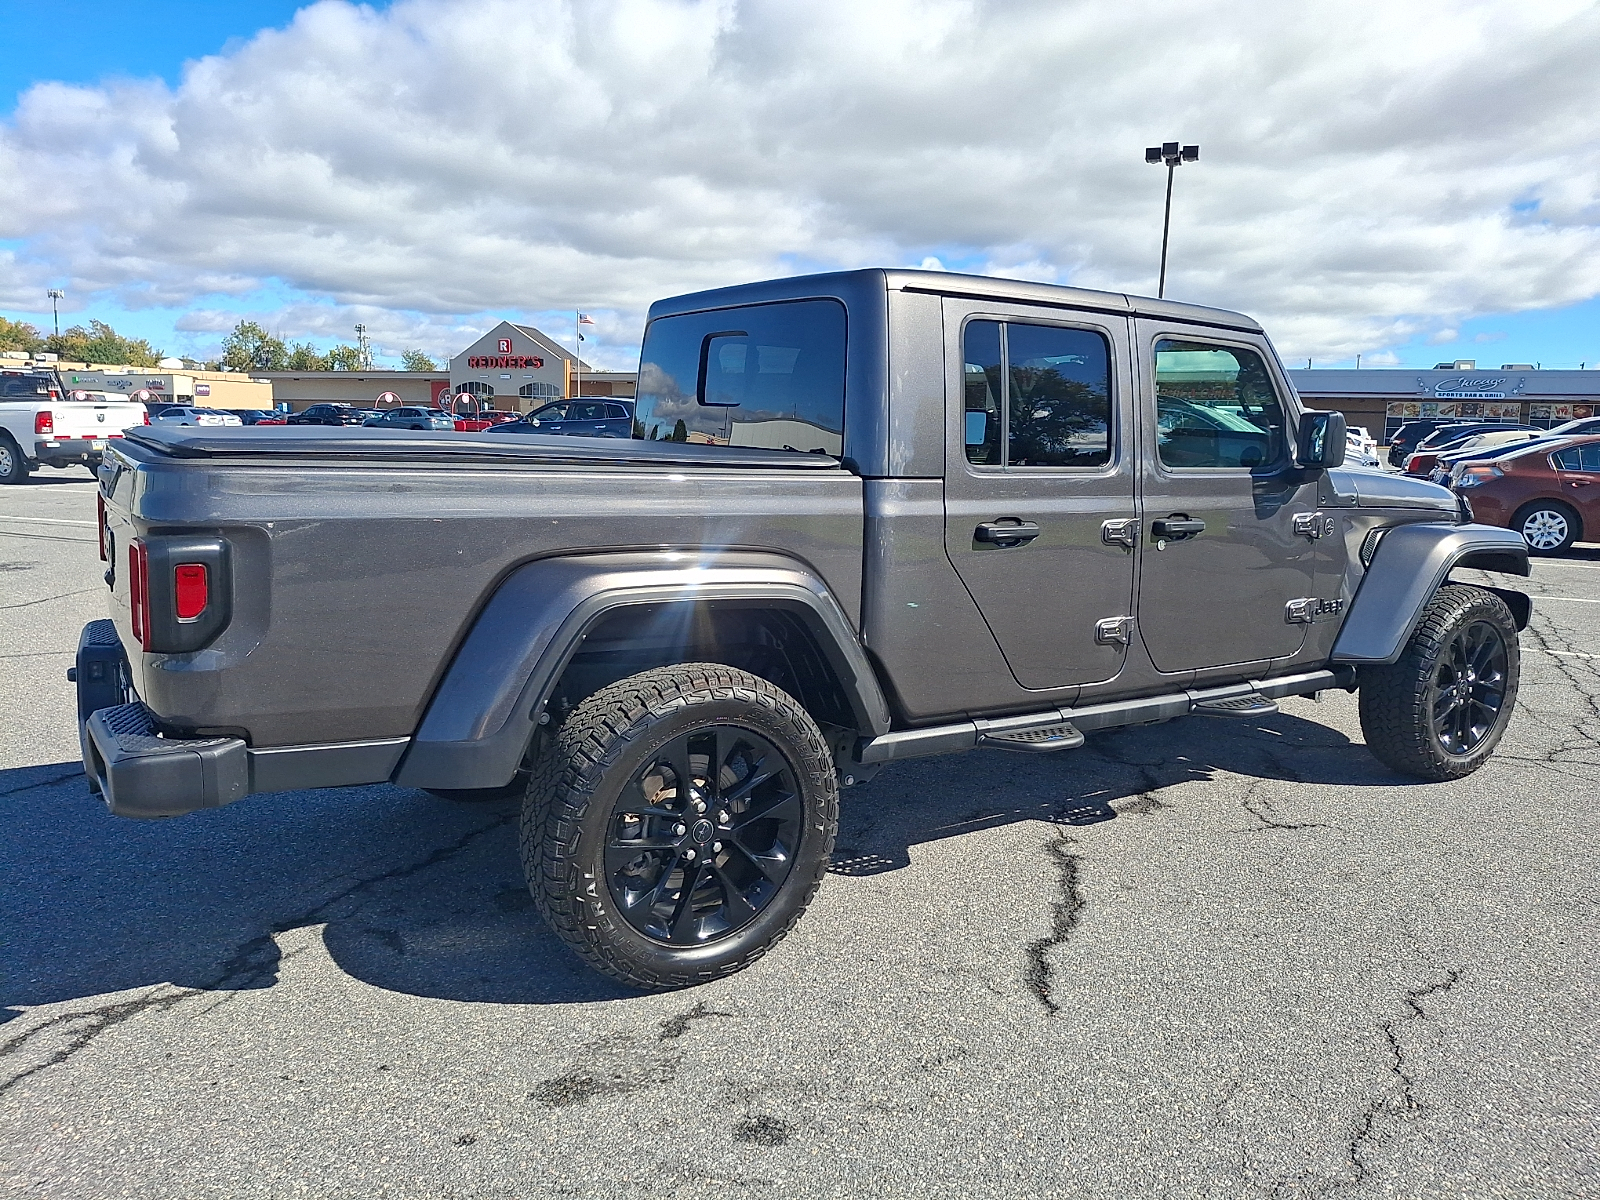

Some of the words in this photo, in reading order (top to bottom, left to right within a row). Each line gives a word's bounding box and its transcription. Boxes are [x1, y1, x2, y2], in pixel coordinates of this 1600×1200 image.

[500, 341, 508, 352] R
[469, 356, 541, 368] REDNER'S
[1435, 377, 1506, 391] Chicago
[1314, 598, 1342, 615] Jeep
[583, 863, 655, 965] GENERAL
